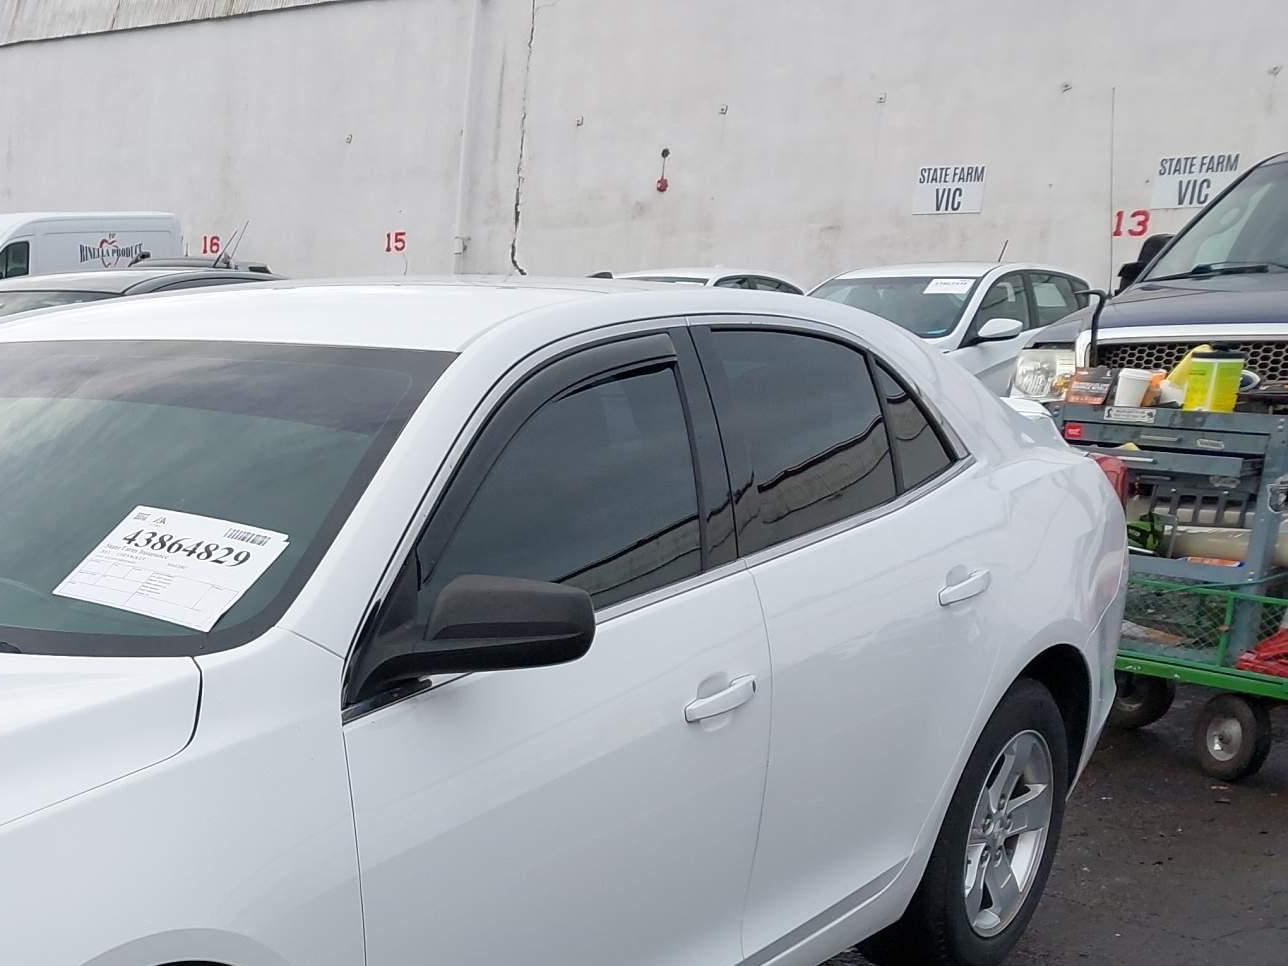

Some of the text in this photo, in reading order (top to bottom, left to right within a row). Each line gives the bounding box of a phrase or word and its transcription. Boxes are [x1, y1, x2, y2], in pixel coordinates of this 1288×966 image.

[919, 166, 985, 184] STATE FARM
[1159, 153, 1240, 176] STATE FARM
[935, 187, 963, 212] VIC
[1177, 178, 1211, 206] VIC
[1112, 209, 1150, 237] 13
[202, 236, 220, 254] 16
[385, 232, 406, 252] 15
[122, 529, 251, 567] 43864829
